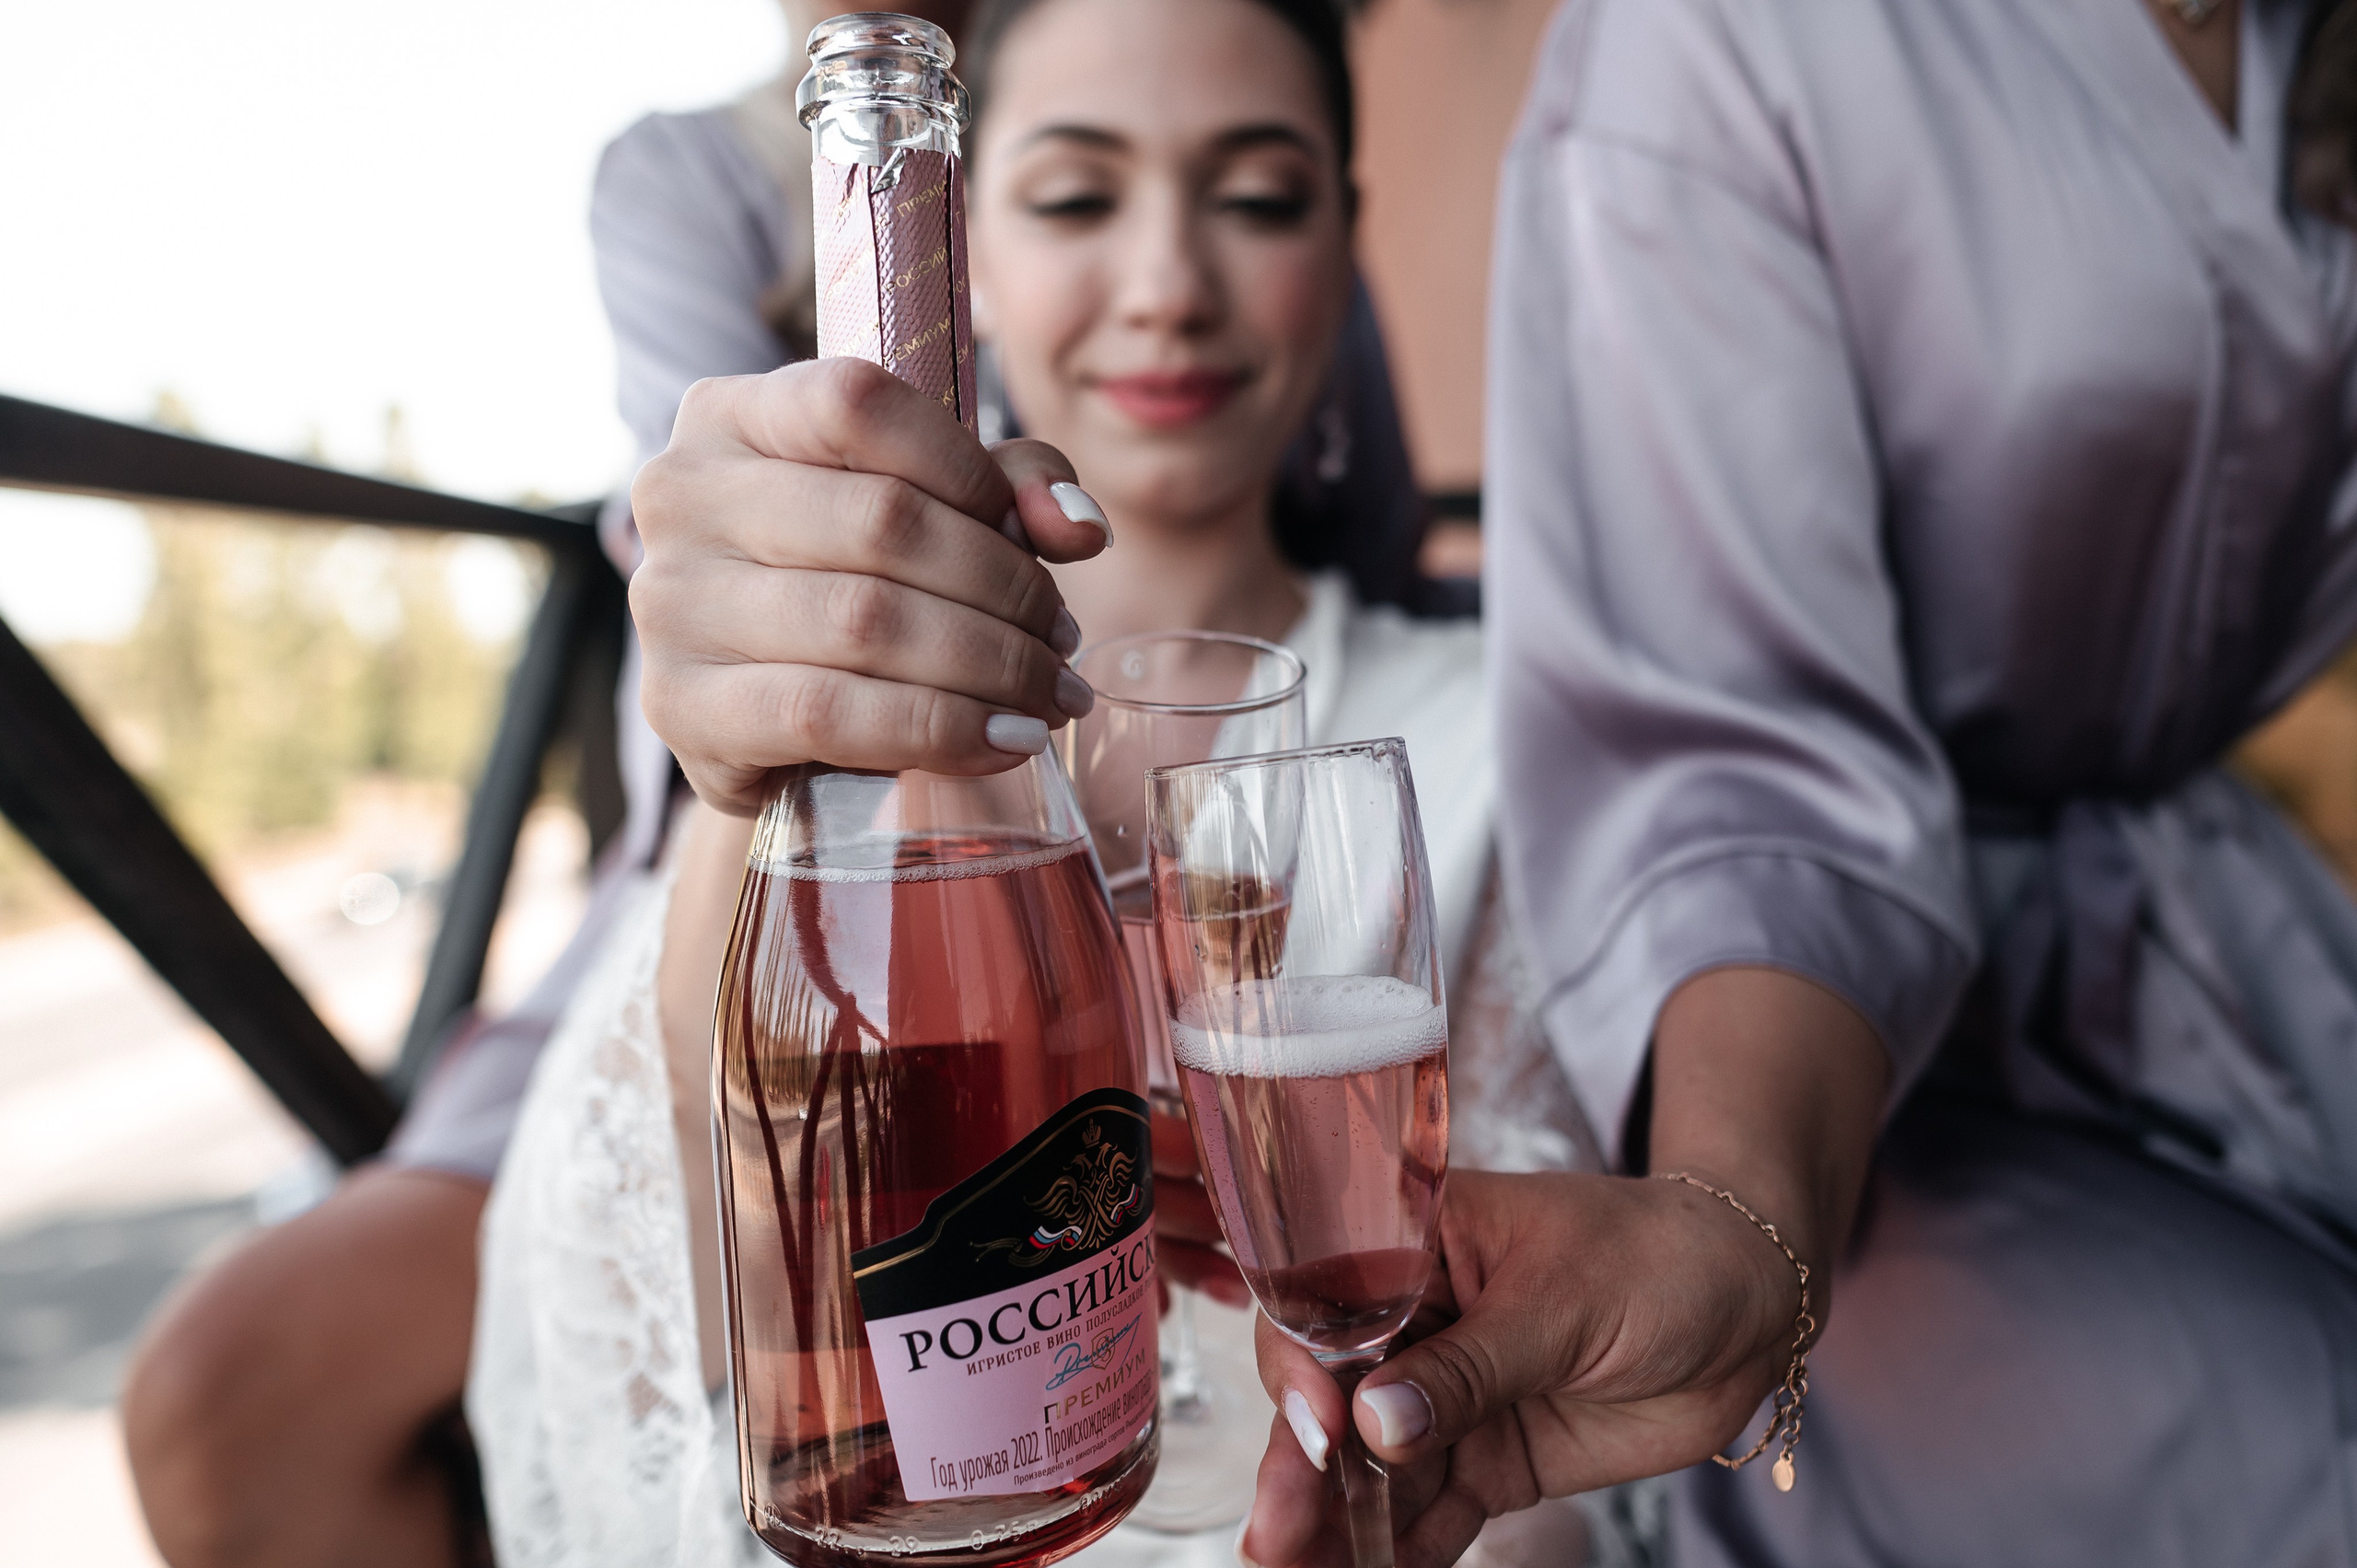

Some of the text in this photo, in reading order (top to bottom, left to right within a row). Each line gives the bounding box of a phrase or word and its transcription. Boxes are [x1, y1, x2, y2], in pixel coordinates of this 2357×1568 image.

[967, 1341, 1041, 1376] ИГРИСТОЕ
[1046, 1325, 1081, 1350] ВИНО
[1086, 1283, 1144, 1333] ПОЛУСЛАДКОЕ
[1043, 1347, 1146, 1424] ПРЕМИУМ
[930, 1457, 958, 1492] Год
[958, 1449, 1010, 1492] урожая
[1011, 1431, 1043, 1469] 2022.
[1044, 1398, 1121, 1463] Происхождение
[1014, 1462, 1064, 1486] Произведено
[1065, 1455, 1074, 1467] из
[1075, 1438, 1108, 1463] винограда
